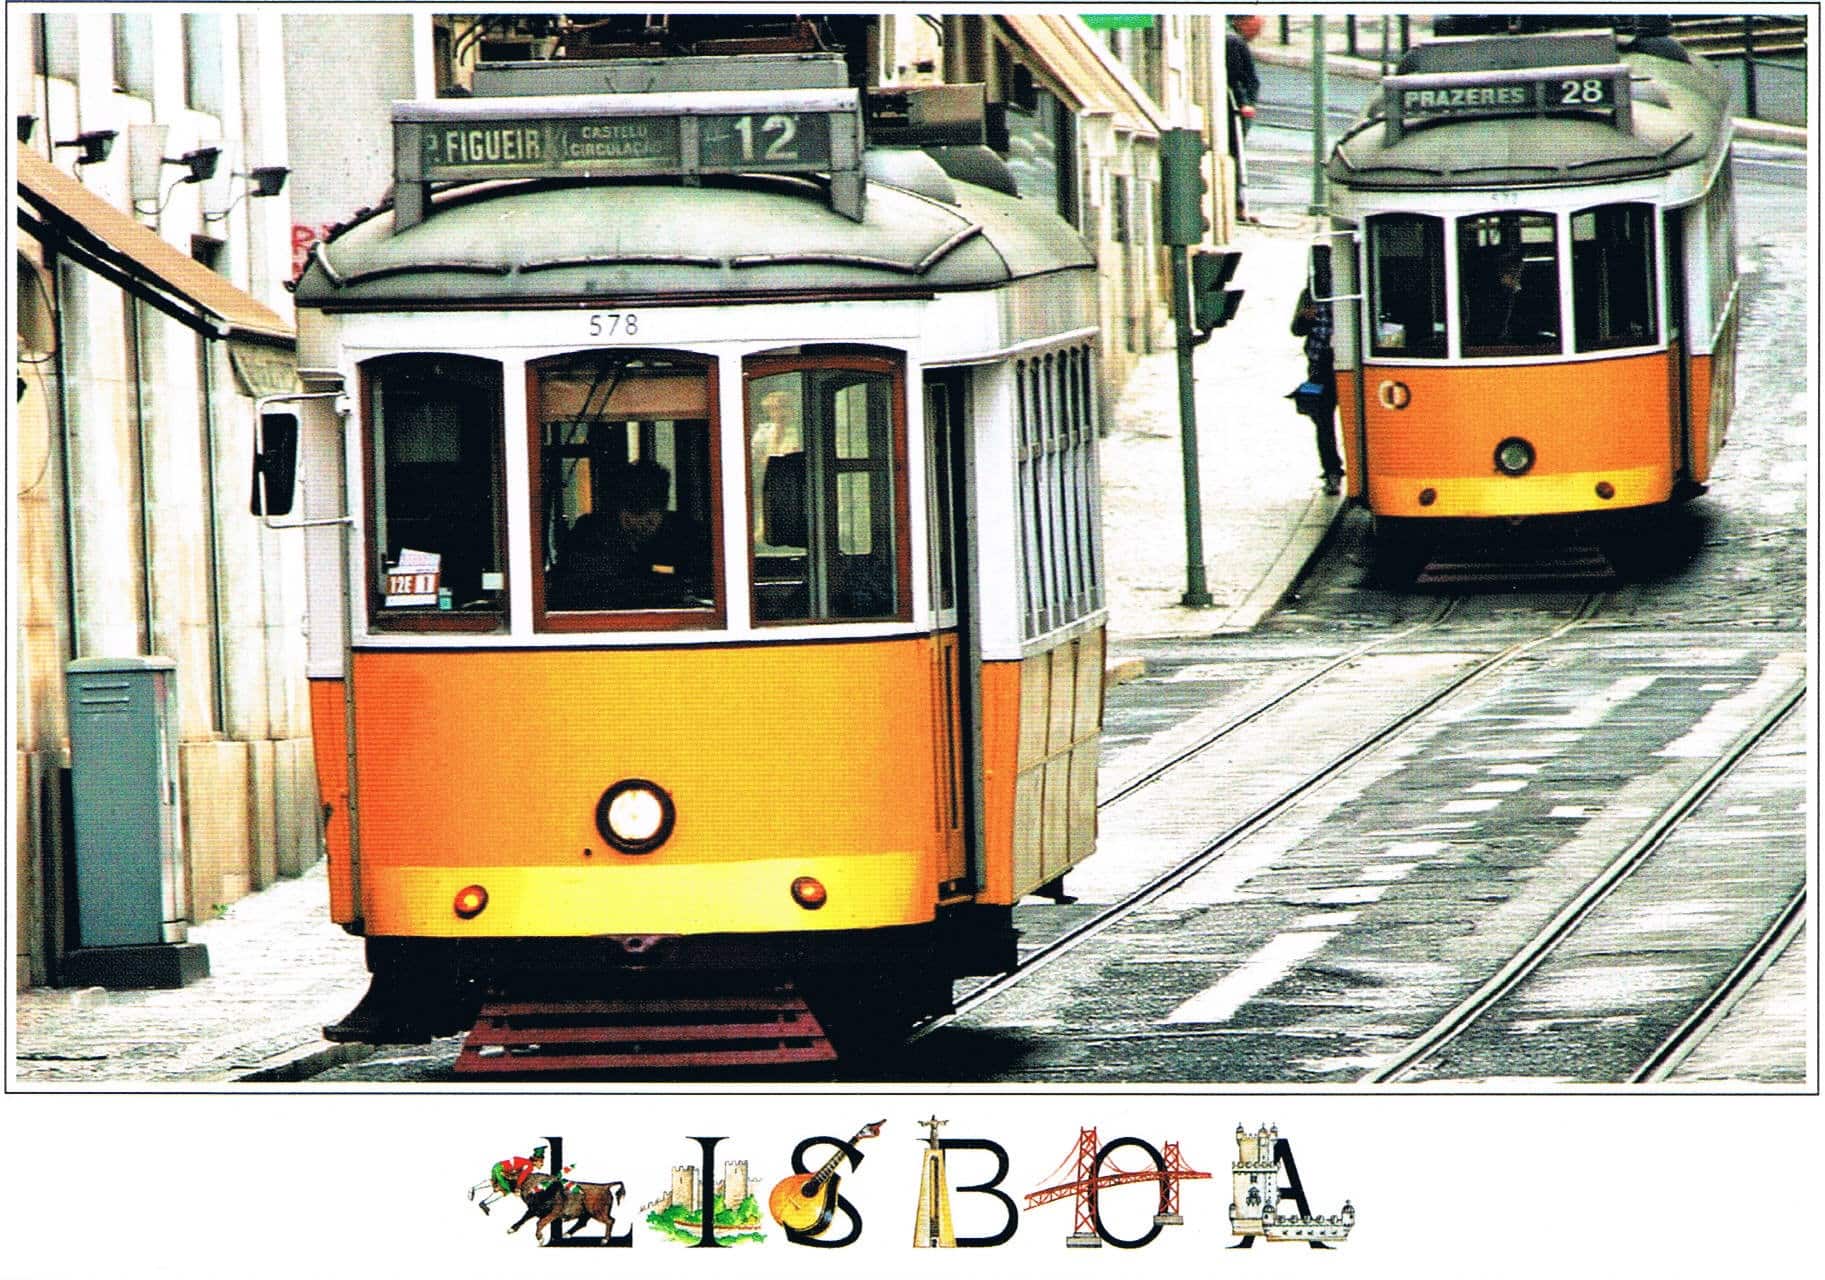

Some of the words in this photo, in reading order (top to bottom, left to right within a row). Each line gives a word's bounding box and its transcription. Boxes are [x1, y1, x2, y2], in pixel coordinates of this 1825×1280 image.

[1403, 87, 1526, 108] PRAZERES
[1561, 79, 1604, 104] 28
[446, 128, 556, 162] FIGUEIR
[734, 114, 799, 161] 12
[589, 313, 639, 337] 578
